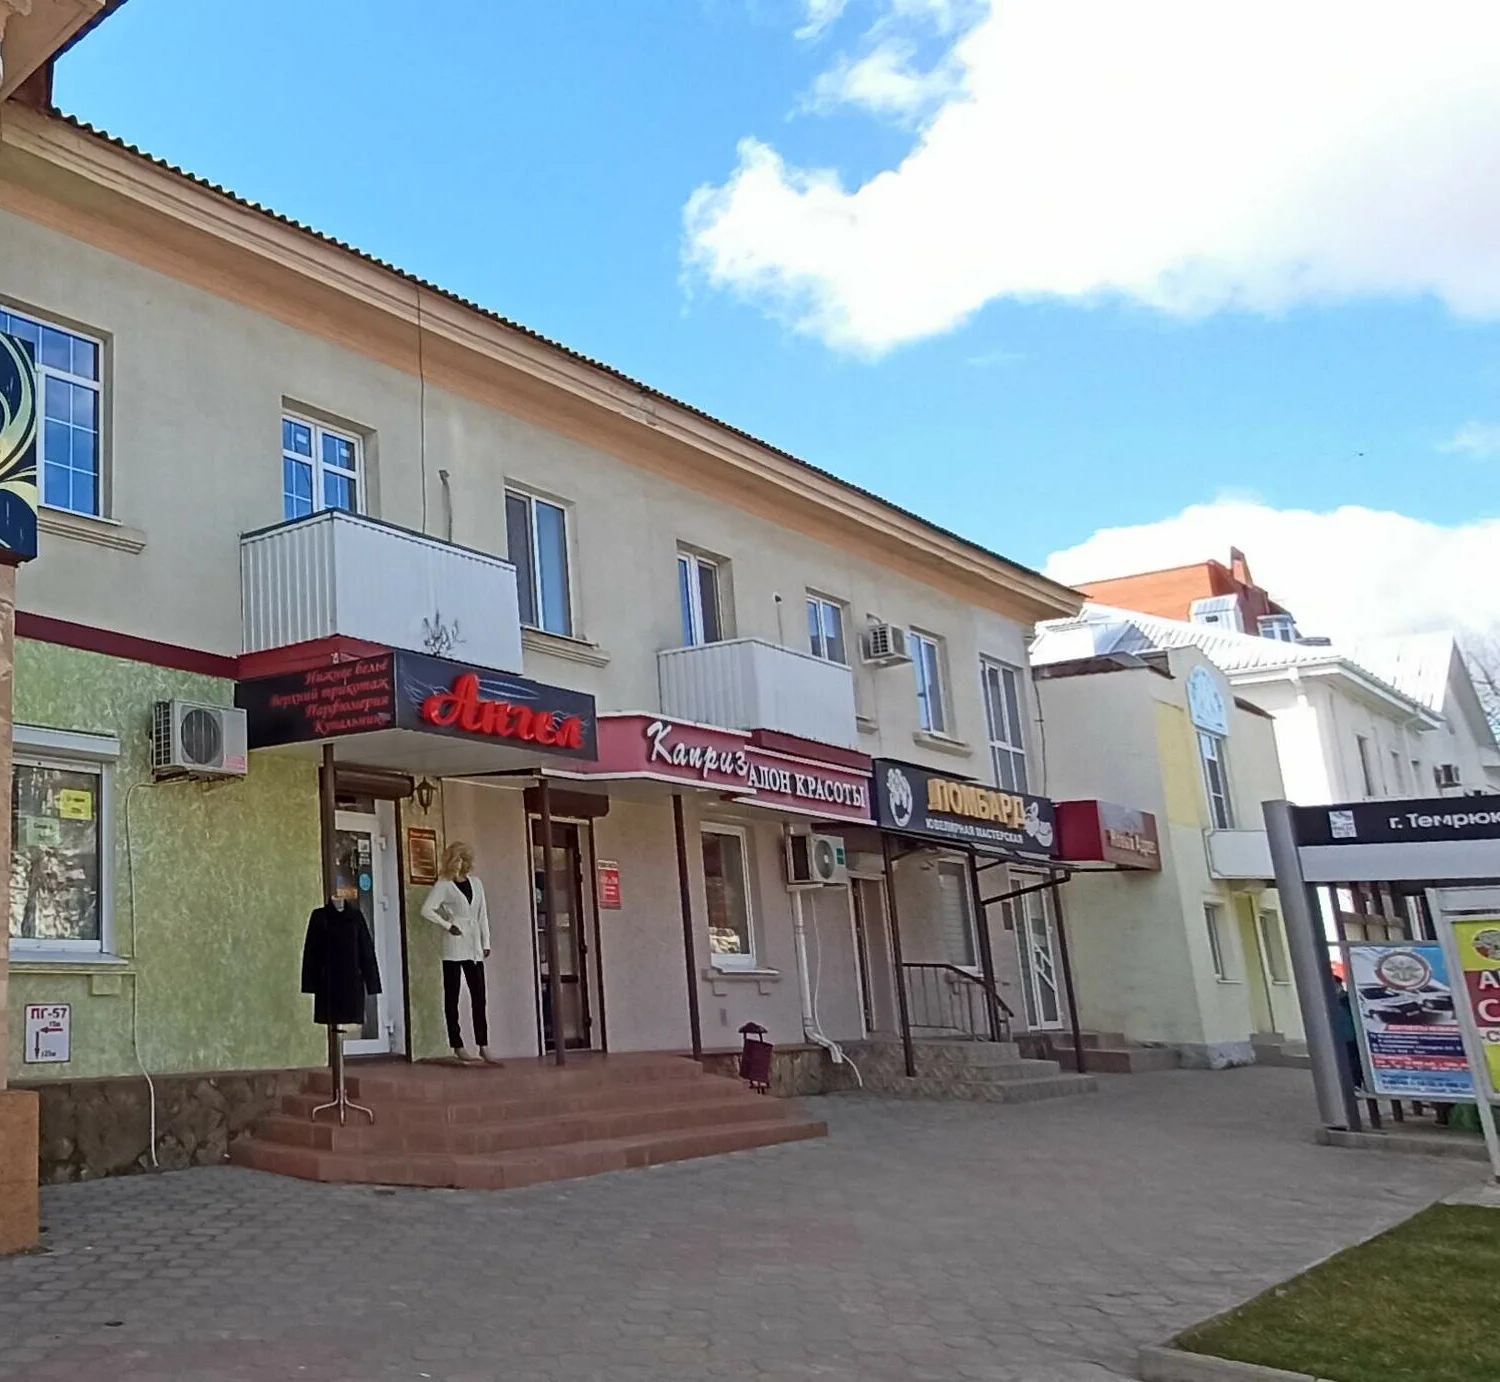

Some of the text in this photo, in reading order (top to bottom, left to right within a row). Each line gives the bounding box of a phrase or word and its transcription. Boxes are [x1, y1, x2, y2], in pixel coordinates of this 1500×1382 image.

[315, 714, 390, 735] Купальник
[422, 671, 579, 750] Ангел
[647, 721, 749, 778] Каприз
[747, 763, 866, 808] АЛОН КРАСОТЫ
[927, 778, 1027, 829] ЛОМБАРД
[1389, 811, 1500, 829] г. Темрюк
[975, 826, 1024, 844] МАСТЕРСКАЯ
[31, 1007, 67, 1019] ПГ-57
